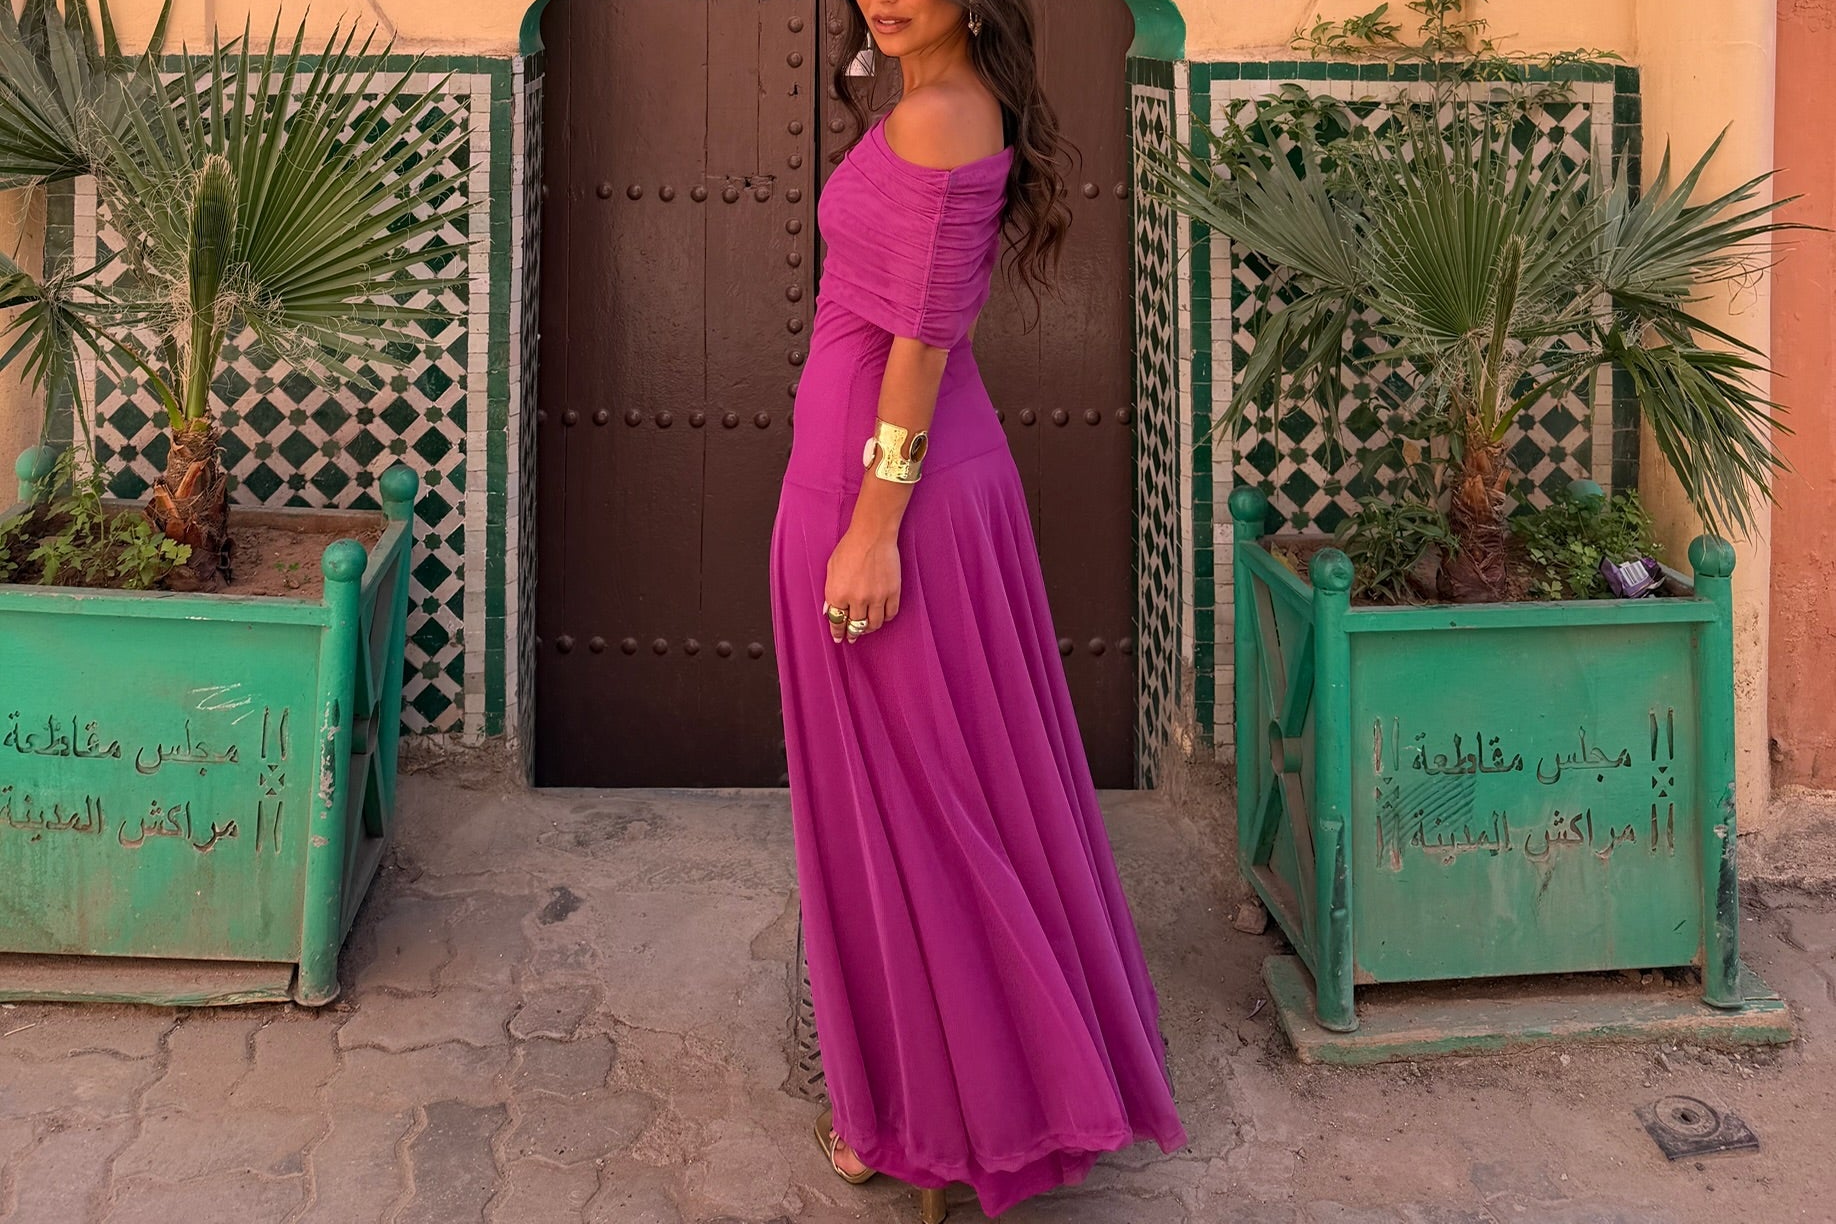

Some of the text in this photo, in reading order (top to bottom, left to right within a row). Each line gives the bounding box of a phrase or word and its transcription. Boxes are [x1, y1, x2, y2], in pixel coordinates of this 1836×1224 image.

[3, 710, 240, 775] مجلس مقاطعة
[1412, 726, 1632, 784] مجلس مقاطعة
[118, 799, 239, 854] مراكش
[1411, 808, 1637, 865] مراكش المدينة
